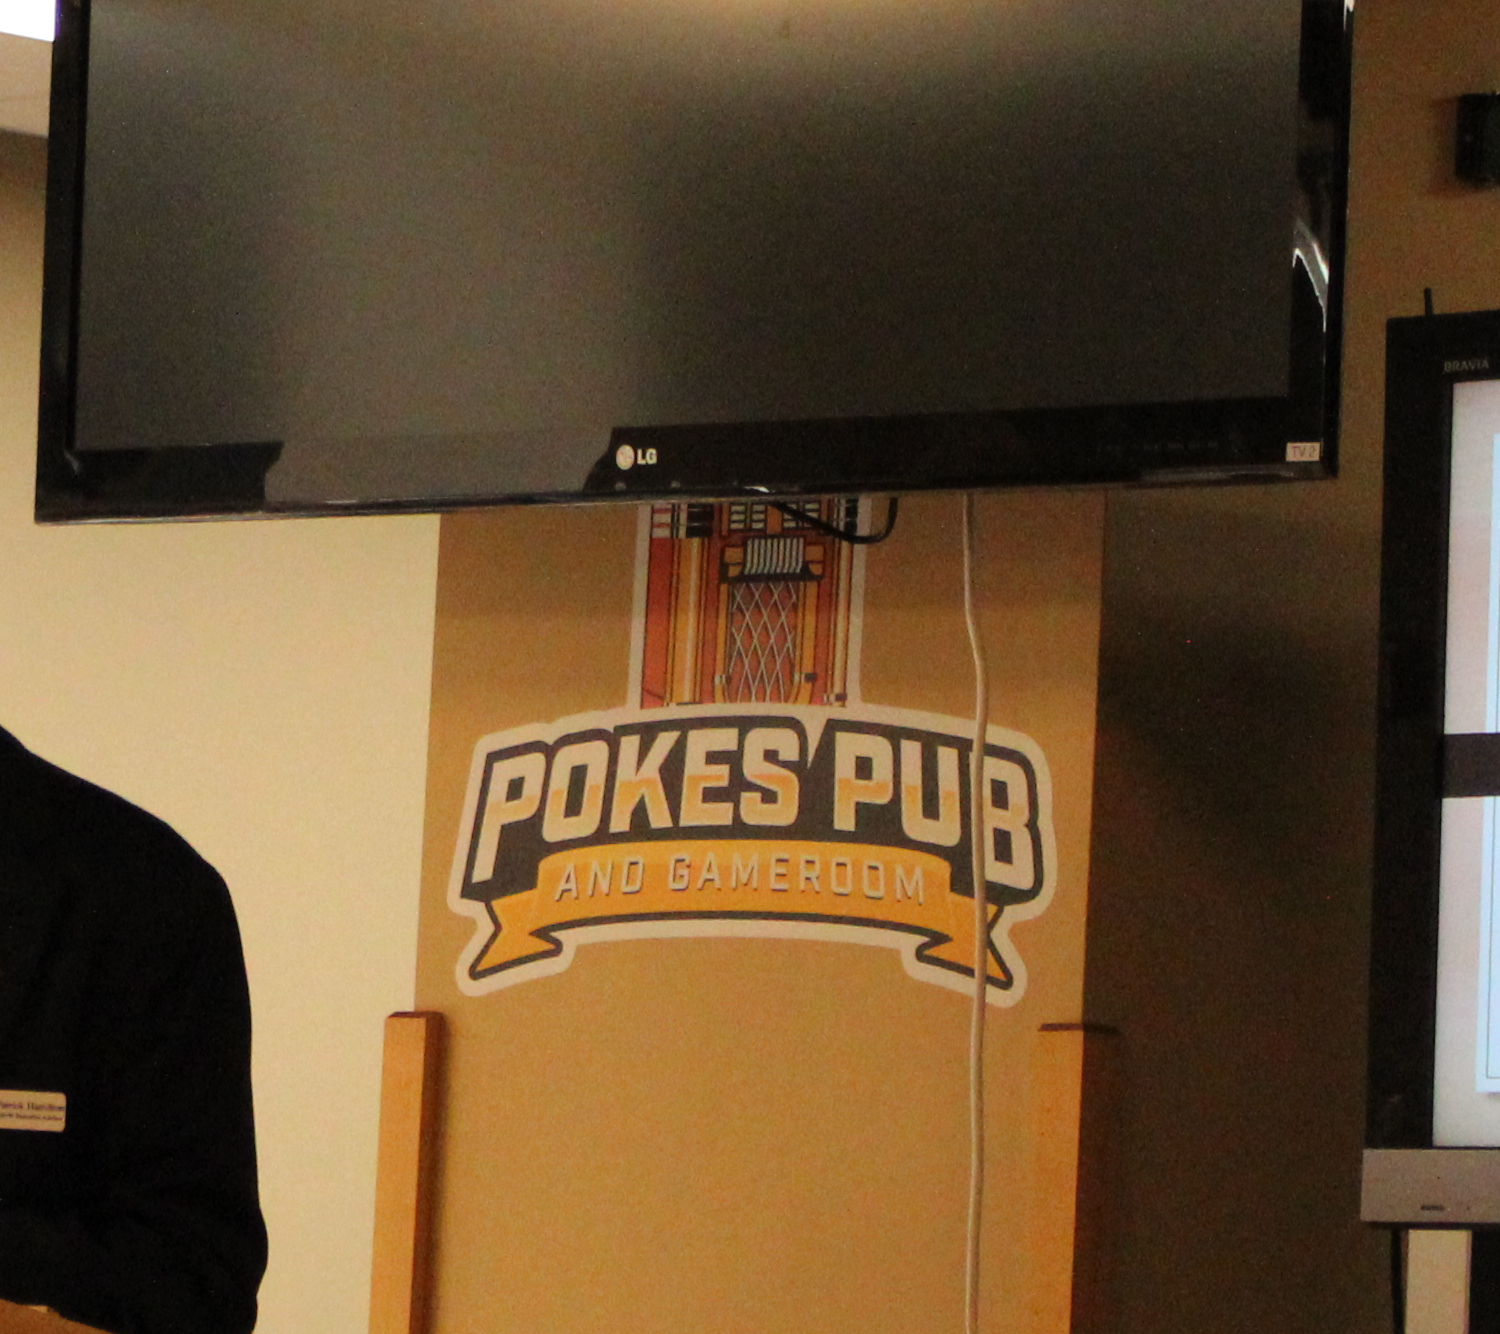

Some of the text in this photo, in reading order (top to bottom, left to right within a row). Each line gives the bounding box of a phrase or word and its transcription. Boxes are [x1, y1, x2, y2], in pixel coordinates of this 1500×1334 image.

[637, 448, 658, 465] LG
[471, 727, 1036, 892] POKES PUB
[554, 851, 926, 905] AND GAMEROOM
